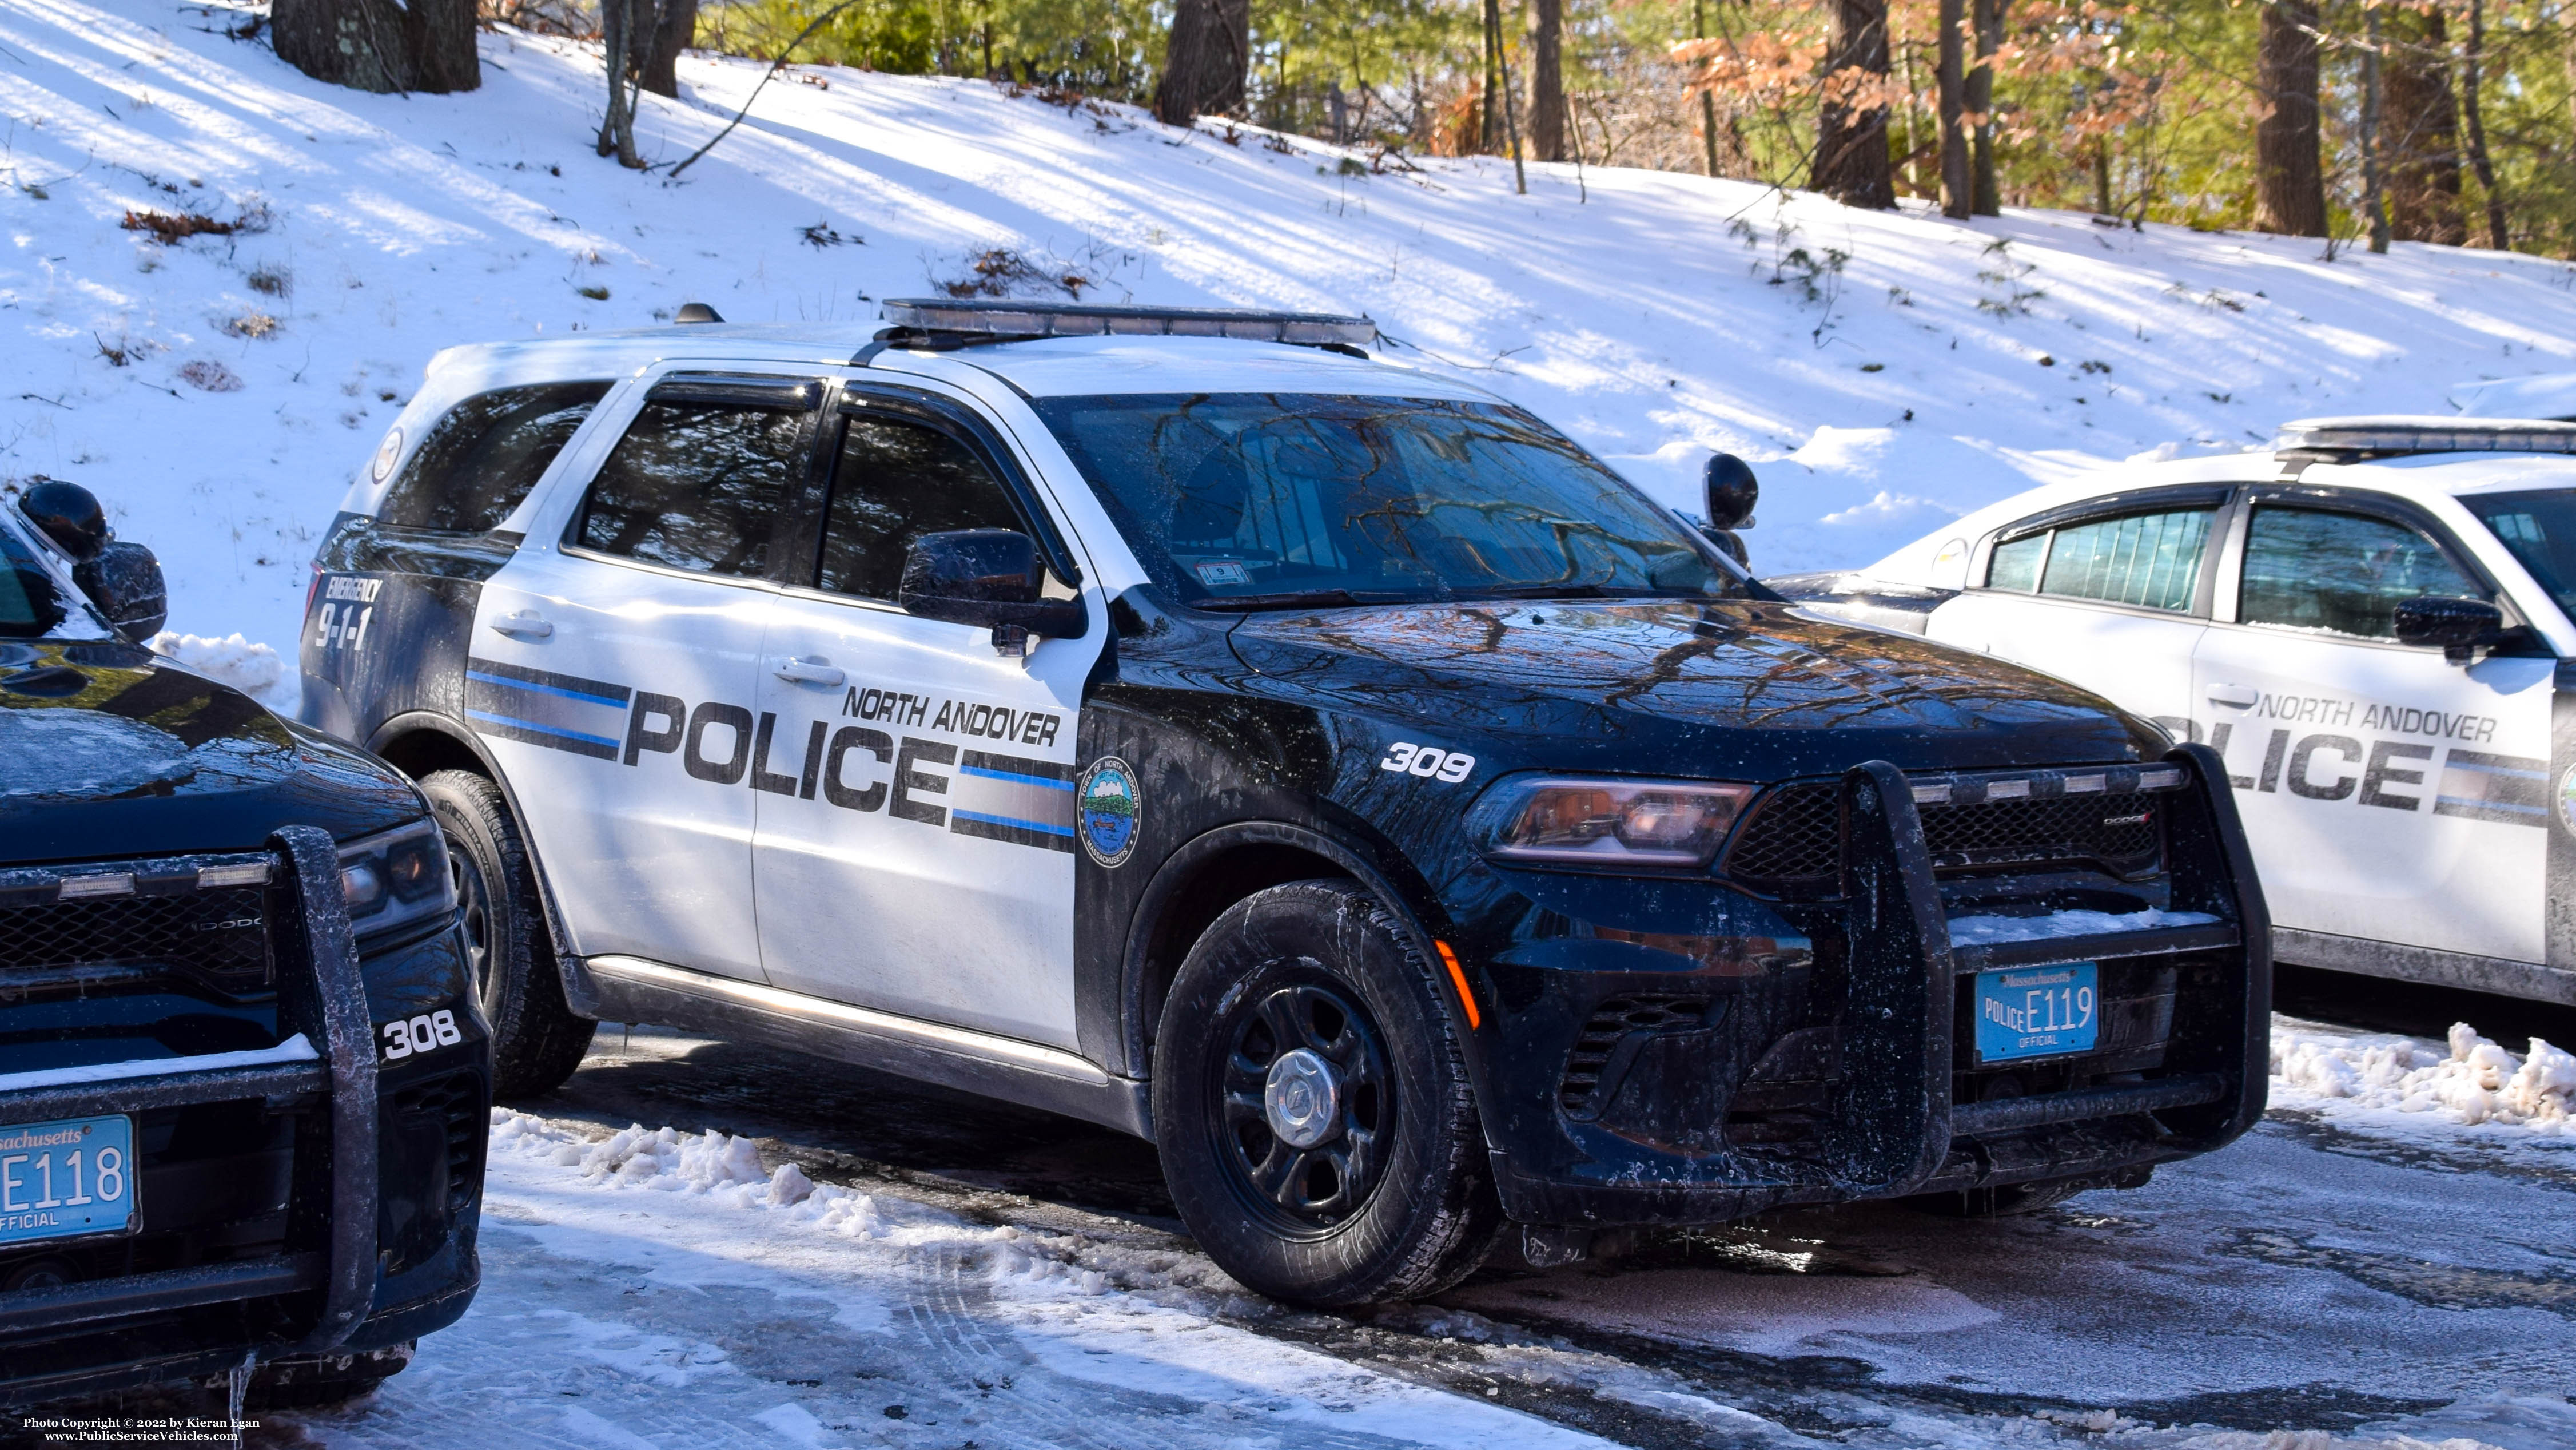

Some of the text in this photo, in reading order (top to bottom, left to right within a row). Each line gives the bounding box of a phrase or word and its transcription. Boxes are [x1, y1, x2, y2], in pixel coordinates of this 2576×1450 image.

[325, 576, 383, 602] EMERGENCY
[316, 602, 373, 651] 9-1-1
[842, 686, 1061, 747] NORTH ANDOVER
[2258, 693, 2498, 742] NORTH ANDOVER
[623, 690, 959, 828] POLICE
[1381, 742, 1475, 783] 309
[1080, 773, 1093, 797] TOWN
[1094, 763, 1101, 773] OF
[1105, 760, 1124, 772] NORTH
[1124, 770, 1140, 809] ANDOVER
[2104, 814, 2145, 825] DODGE
[1086, 839, 1128, 864] MASSACHUSETTS
[2003, 972, 2071, 987] Massachusetts
[384, 1009, 461, 1059] 308
[1985, 986, 2093, 1034] POLICE E119
[2019, 1035, 2059, 1048] OFFICIAL
[2, 1146, 124, 1212] E118
